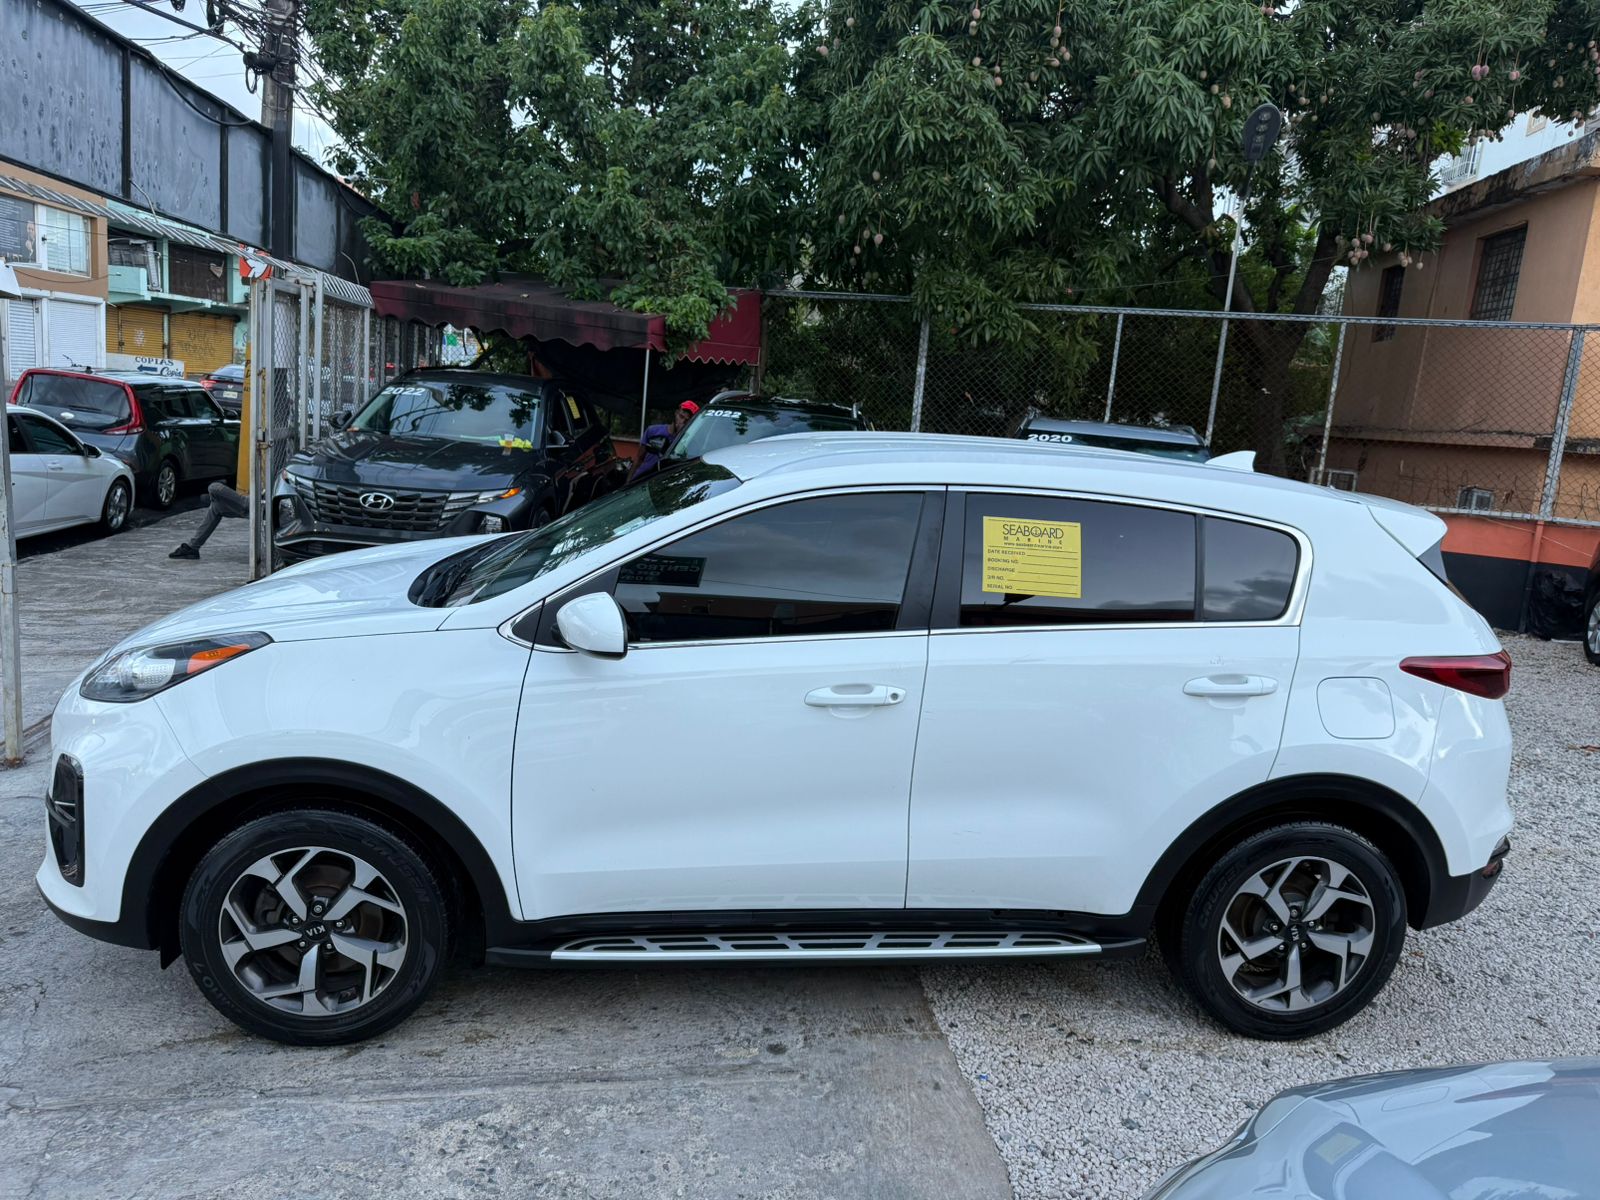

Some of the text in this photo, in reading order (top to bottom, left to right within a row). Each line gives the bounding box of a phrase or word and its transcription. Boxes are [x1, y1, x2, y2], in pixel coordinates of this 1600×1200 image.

[135, 356, 174, 366] COPIAS
[381, 386, 426, 396] 2022
[704, 409, 742, 418] 2022
[1027, 433, 1073, 443] 2020
[1002, 523, 1064, 540] SEABOARD
[305, 924, 326, 937] KIA
